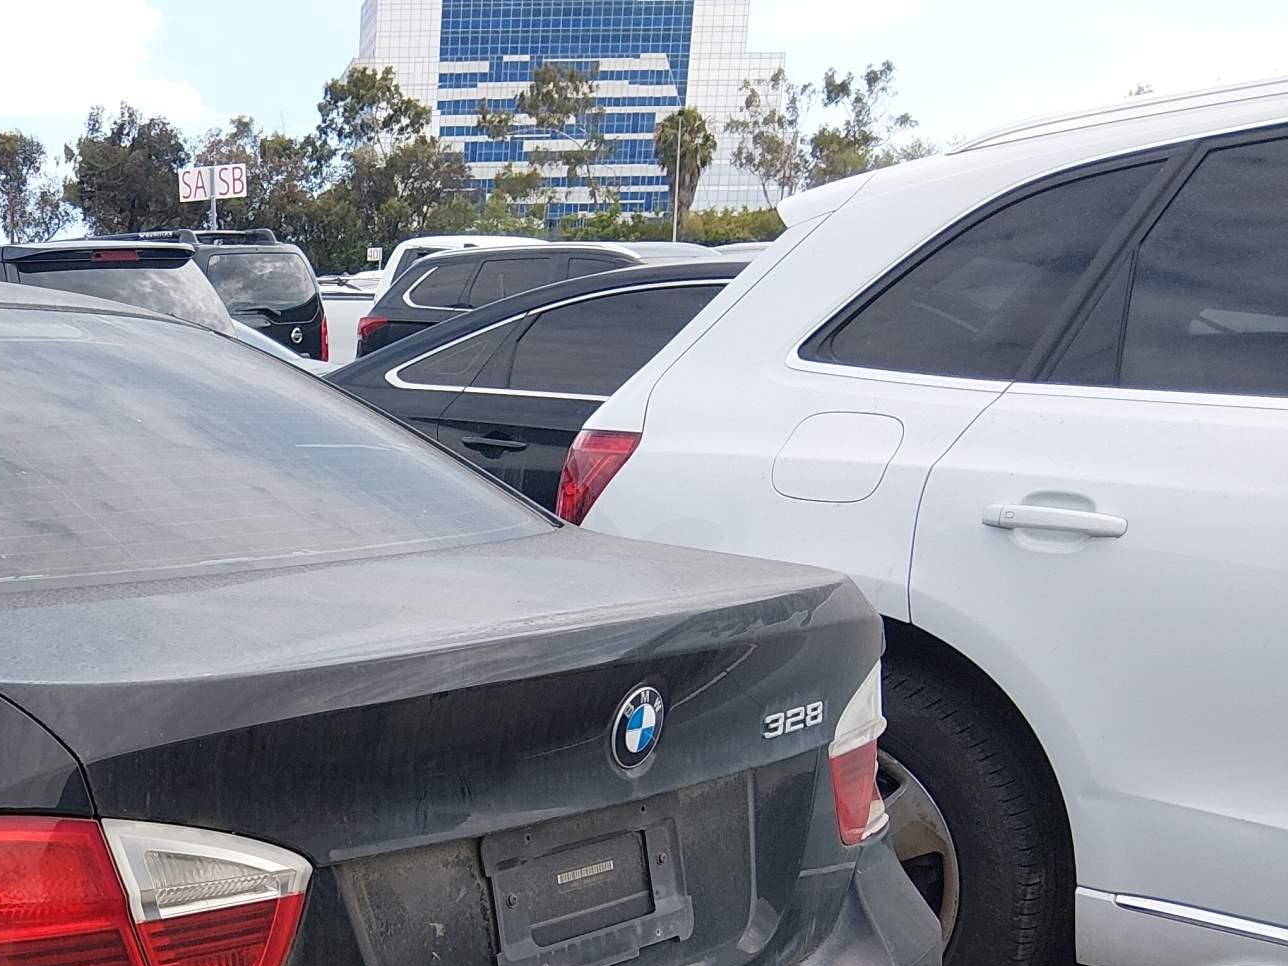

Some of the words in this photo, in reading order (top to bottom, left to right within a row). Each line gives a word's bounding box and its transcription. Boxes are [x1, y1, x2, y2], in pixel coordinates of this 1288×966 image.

[182, 170, 208, 199] SA
[218, 166, 244, 196] SB
[623, 690, 662, 719] BMW
[763, 701, 823, 739] 328
